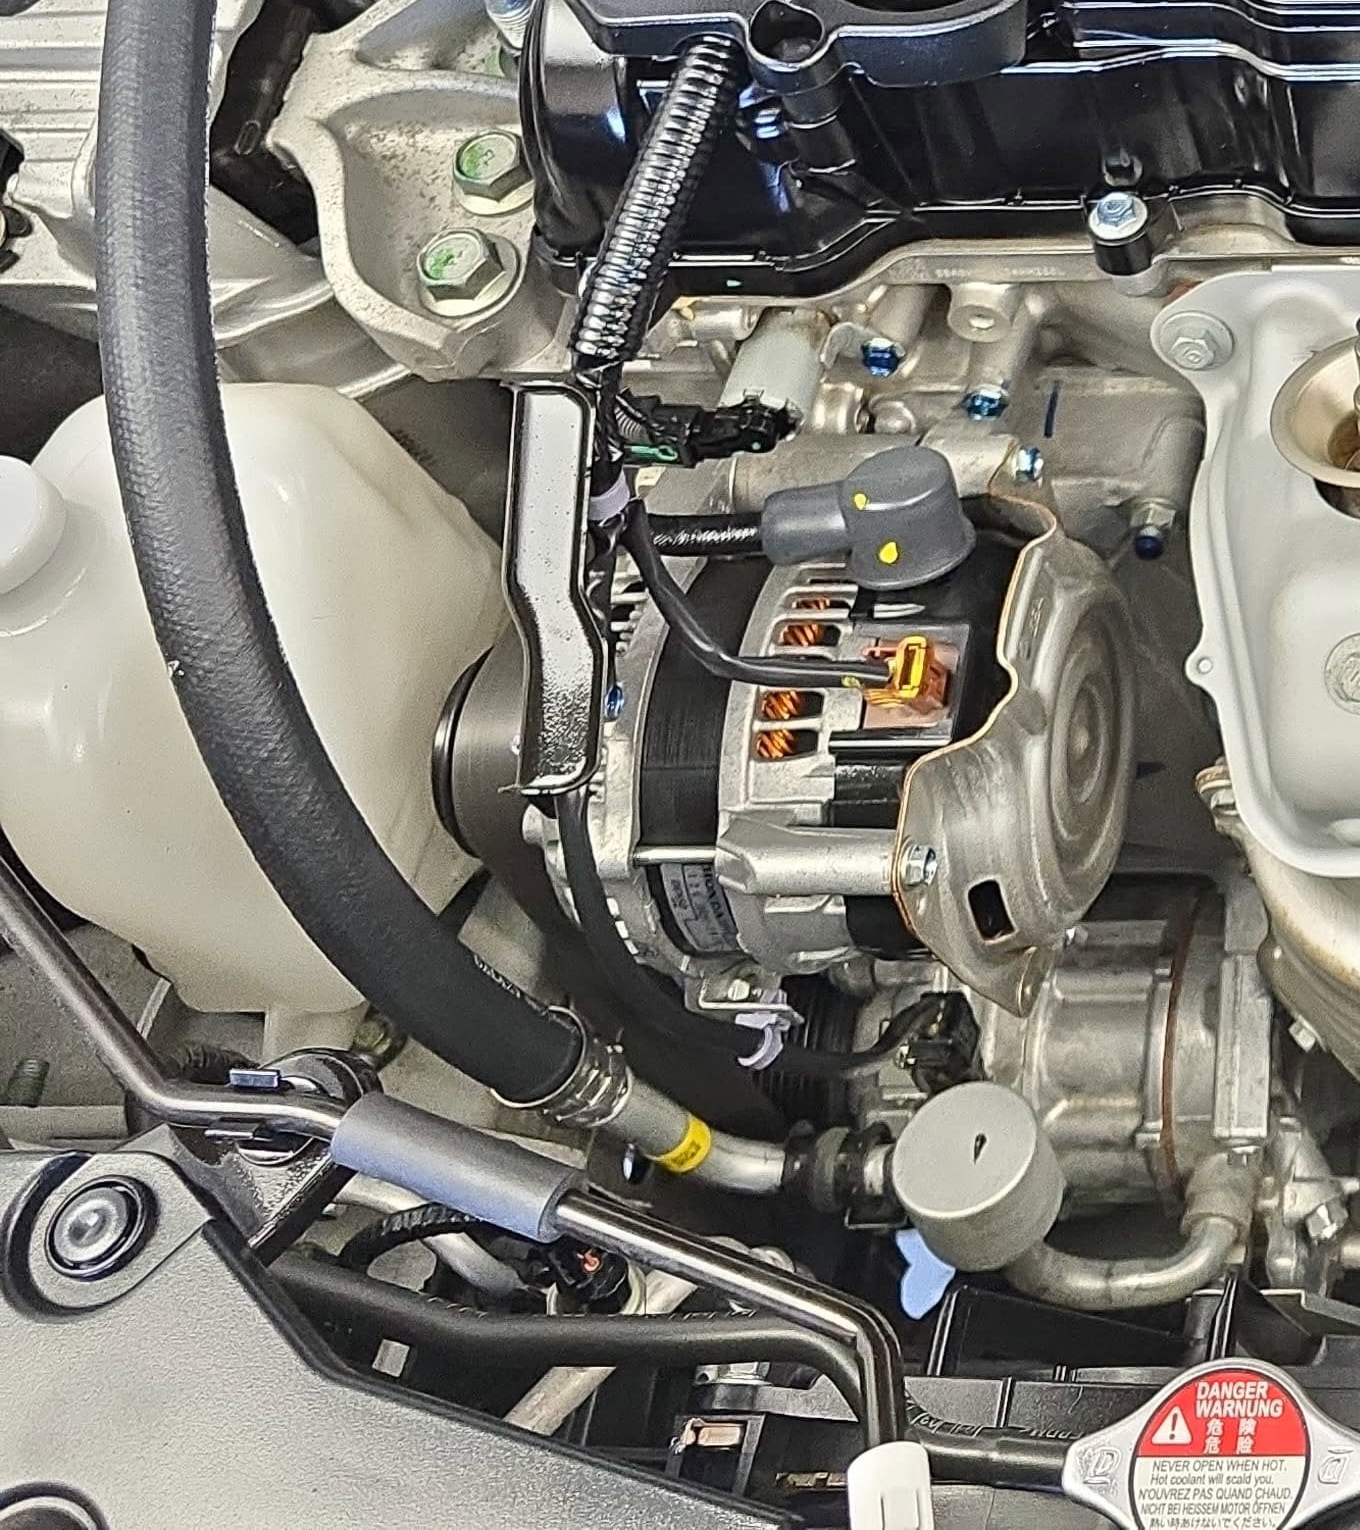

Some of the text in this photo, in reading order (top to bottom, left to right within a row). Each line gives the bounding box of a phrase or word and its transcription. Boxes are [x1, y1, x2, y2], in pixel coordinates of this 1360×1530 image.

[1196, 1381, 1269, 1399] DANGER
[1196, 1399, 1283, 1418] WARNUNG
[1152, 1459, 1287, 1472] NEVER OPEN WHEN HOT.
[1150, 1473, 1274, 1487] Hot coolant will scald you.
[1138, 1488, 1293, 1500] N'OUVREZ PAS QUAND CHAUD.
[1141, 1503, 1166, 1515] NICHT
[1168, 1503, 1181, 1515] BEI
[1183, 1503, 1219, 1515] HEISSEM
[1220, 1502, 1250, 1514] MOTOR
